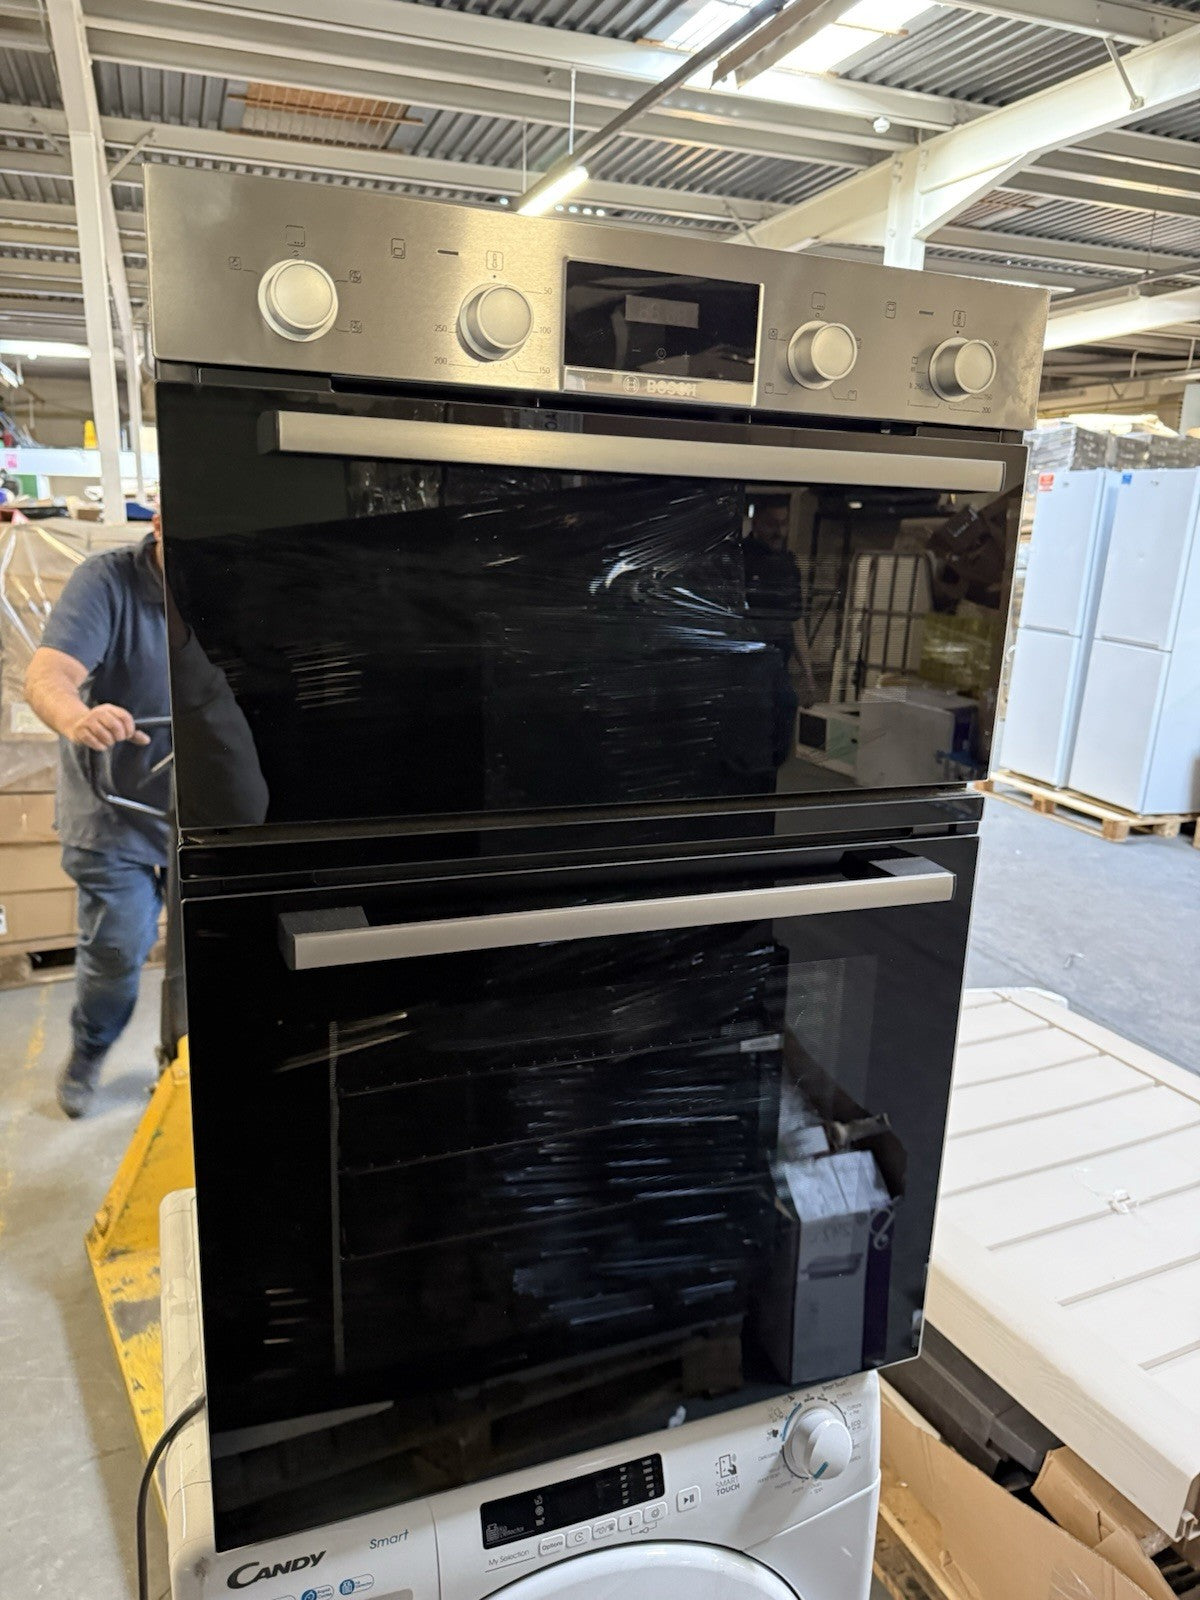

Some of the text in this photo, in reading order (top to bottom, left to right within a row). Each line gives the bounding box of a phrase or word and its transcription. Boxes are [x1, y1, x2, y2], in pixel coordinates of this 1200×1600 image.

[544, 287, 553, 295] 50
[434, 324, 448, 333] 250
[540, 326, 552, 334] 100
[434, 356, 448, 365] 200
[539, 367, 551, 375] 150
[646, 378, 698, 397] BOSCH
[715, 1475, 740, 1489] SMART
[716, 1483, 740, 1496] TOUCH
[369, 1528, 410, 1550] Smart
[541, 1540, 564, 1552] Options
[488, 1549, 530, 1567] My Selection
[226, 1549, 327, 1590] CANDY
